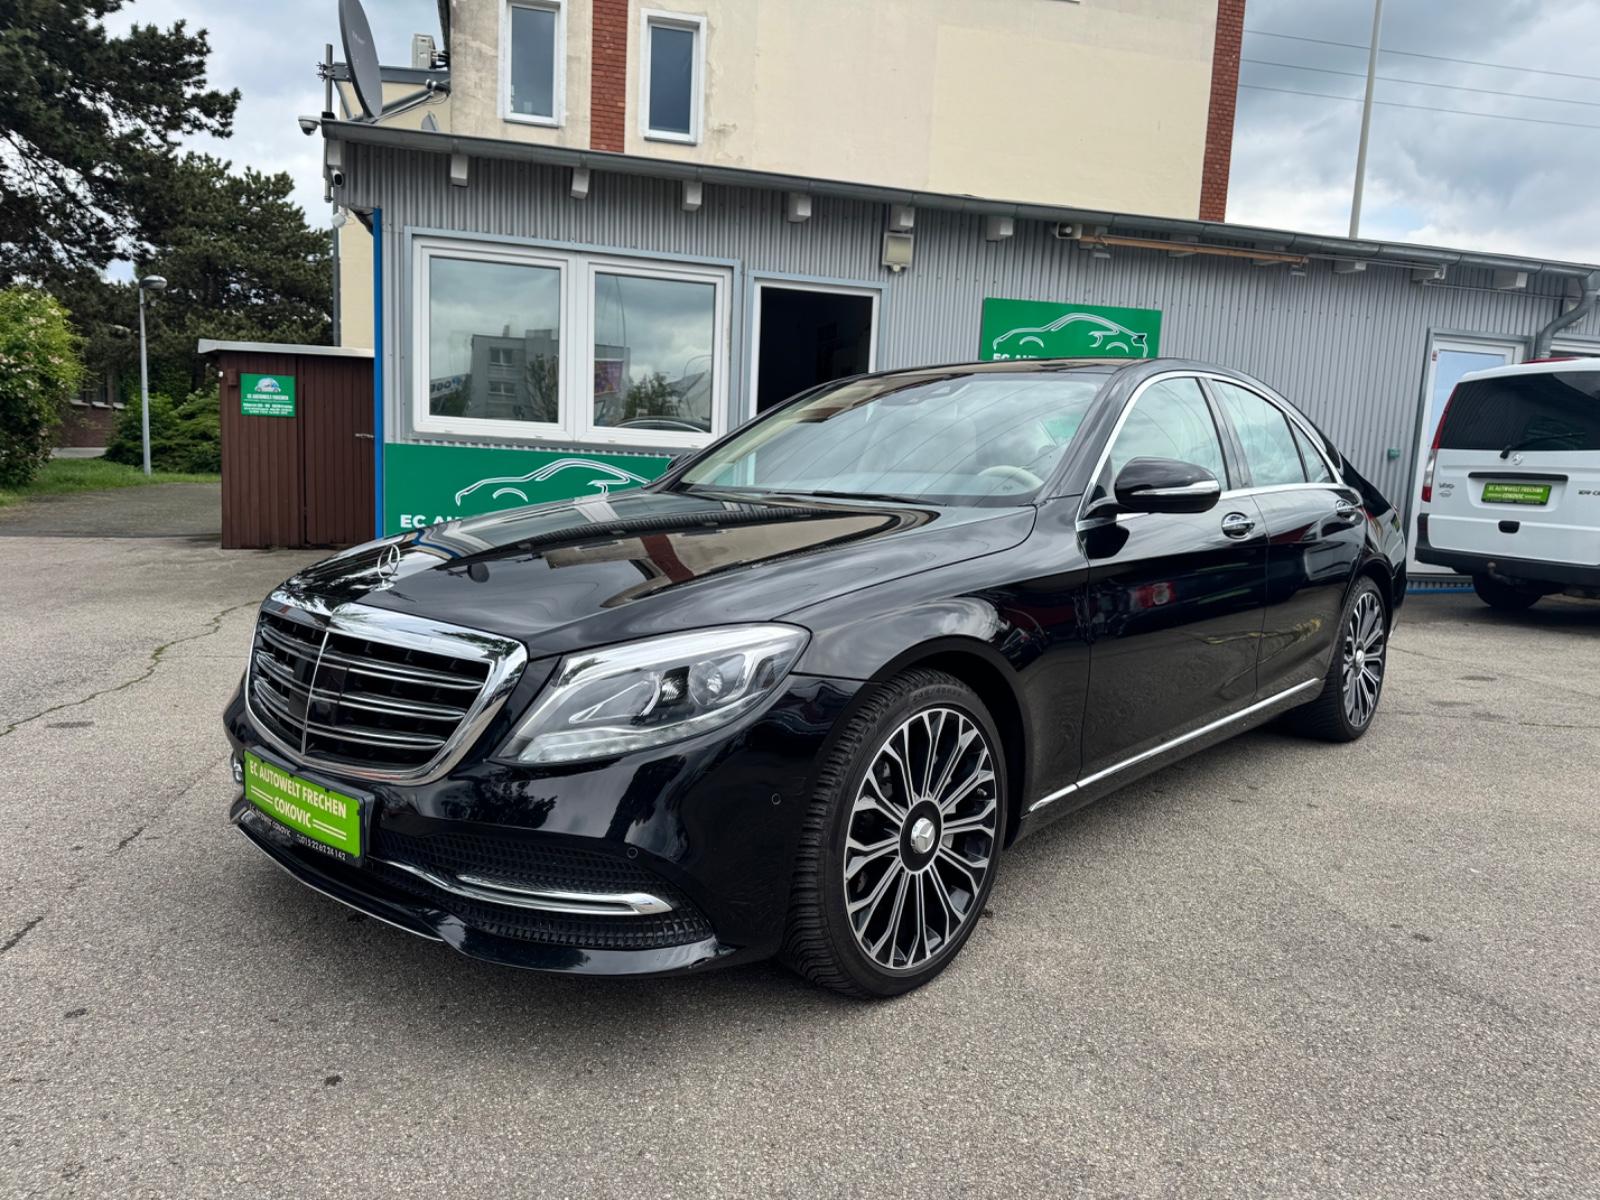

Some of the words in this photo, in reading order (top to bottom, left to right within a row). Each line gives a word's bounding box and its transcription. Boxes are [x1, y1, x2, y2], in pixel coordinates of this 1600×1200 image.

[400, 514, 427, 529] EC
[249, 760, 258, 777] EC
[259, 765, 301, 799] AUTOWELT
[302, 785, 347, 820] FRECHEN
[274, 796, 312, 829] COKOVIC
